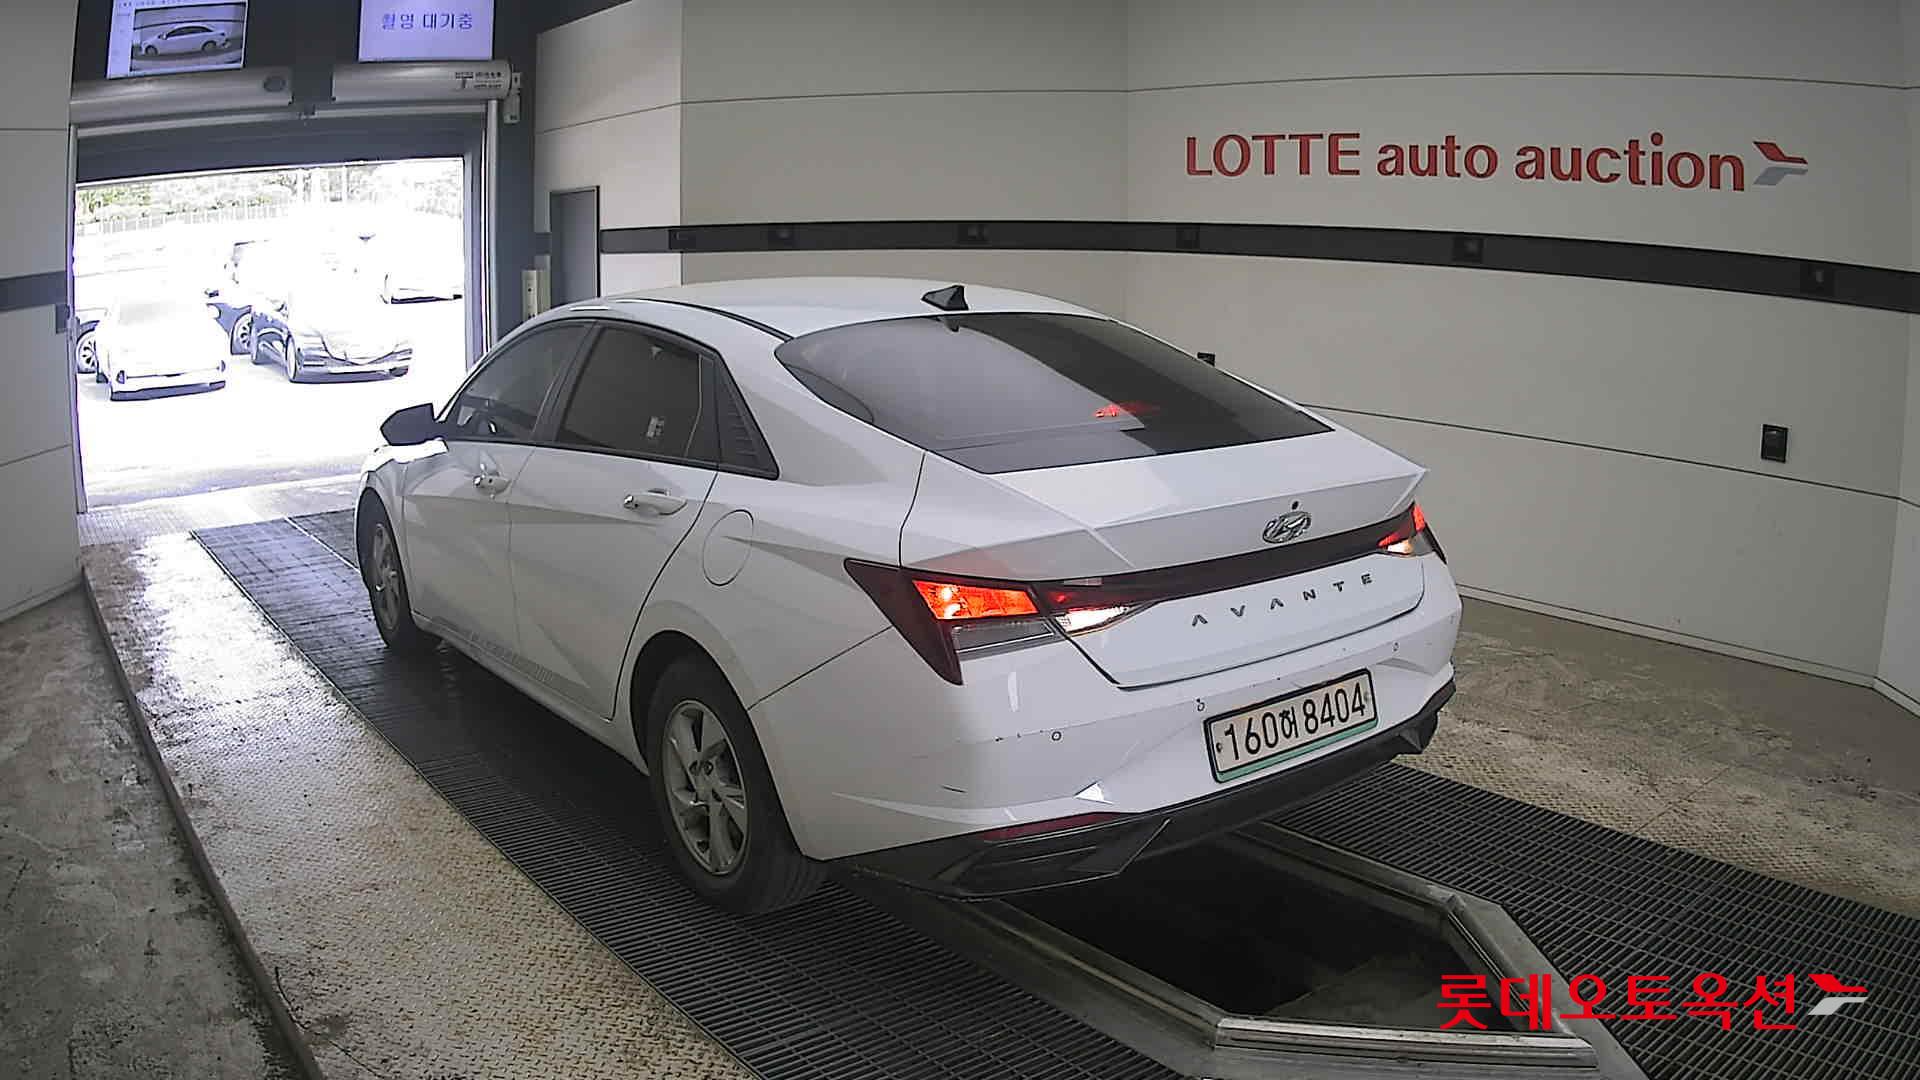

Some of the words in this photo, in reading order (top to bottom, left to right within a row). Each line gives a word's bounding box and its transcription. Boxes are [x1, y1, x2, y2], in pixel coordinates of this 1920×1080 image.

[423, 13, 473, 30] 대기중
[1187, 133, 1361, 176] LOTTE
[1377, 134, 1499, 178] auto
[1515, 132, 1745, 191] auction
[1192, 573, 1373, 627] AVANTE
